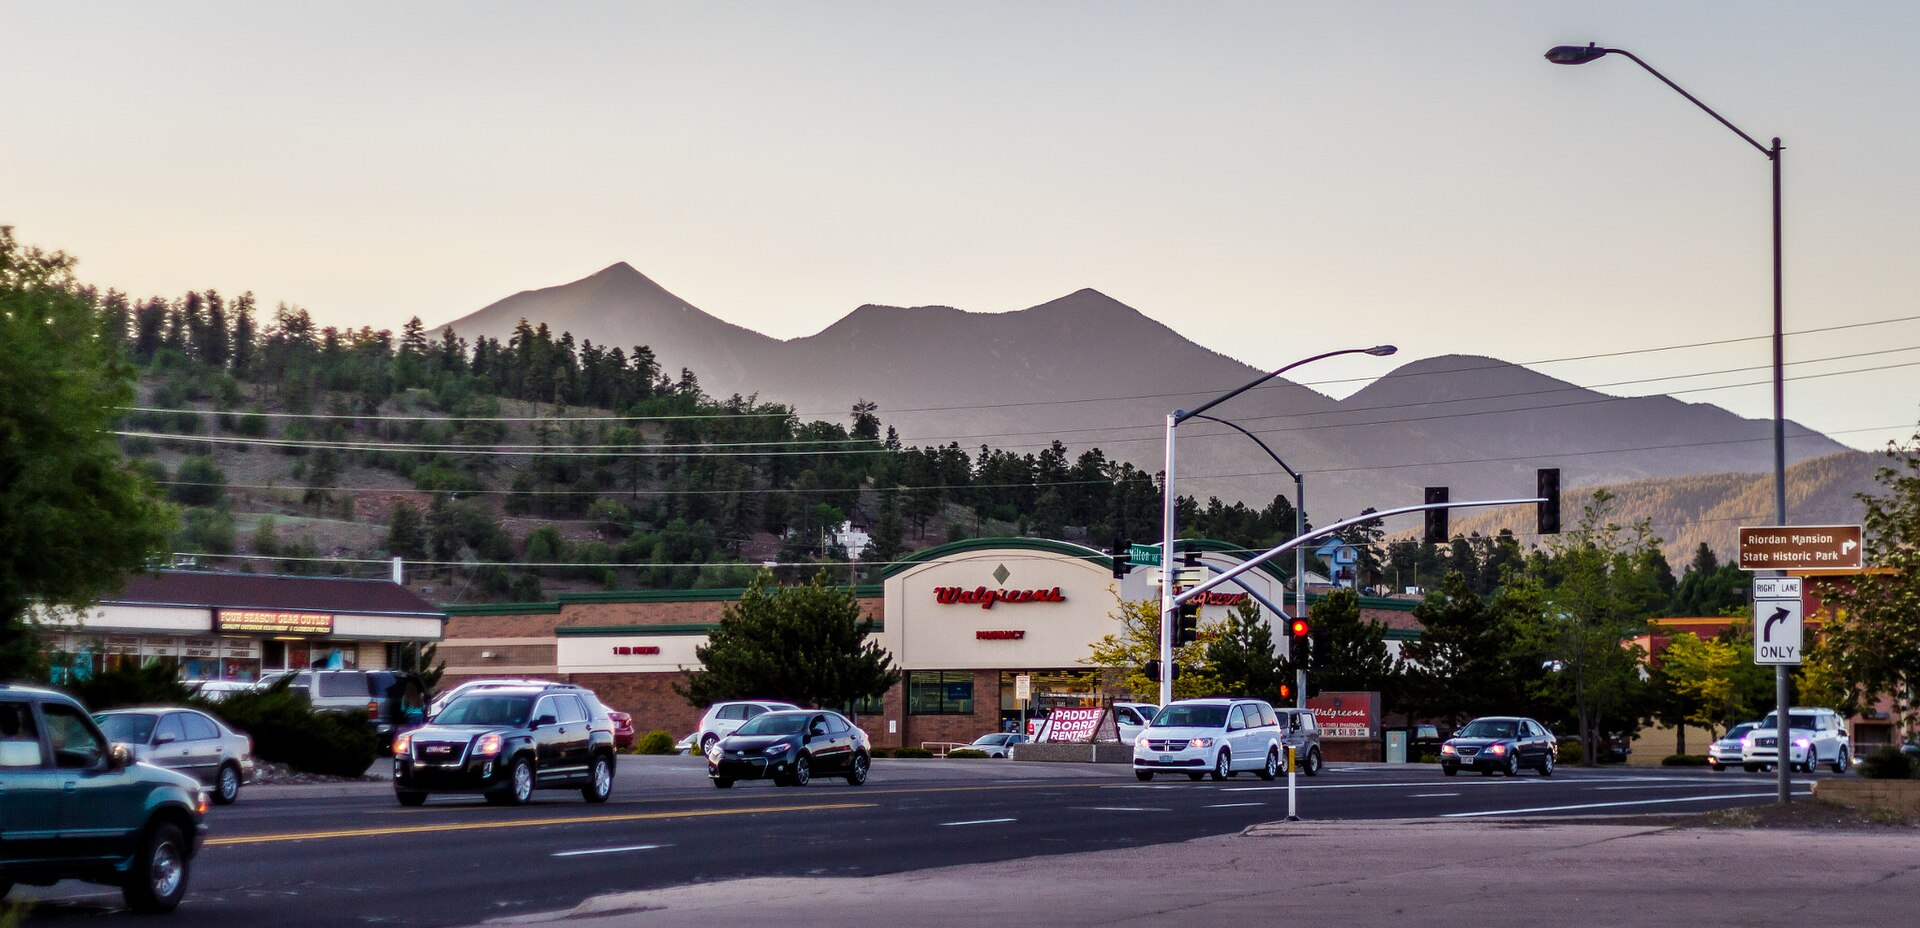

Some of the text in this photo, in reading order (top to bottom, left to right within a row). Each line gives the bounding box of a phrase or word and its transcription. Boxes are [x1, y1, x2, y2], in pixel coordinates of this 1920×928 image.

[1748, 534, 1833, 544] Riordan Mansion
[1129, 548, 1150, 561] Milton
[1743, 550, 1838, 562] State Historic Park
[1757, 583, 1798, 593] RIGHT LANE
[933, 586, 1065, 610] Walgreens
[221, 611, 330, 626] FOUR SEASON GEAR OUTLET
[612, 646, 617, 655] 1
[1760, 646, 1795, 659] ONLY
[1055, 710, 1100, 721] PADDLE
[1312, 708, 1365, 718] Walgreens
[1053, 720, 1097, 731] BOARD
[1050, 730, 1095, 741] RENTALS
